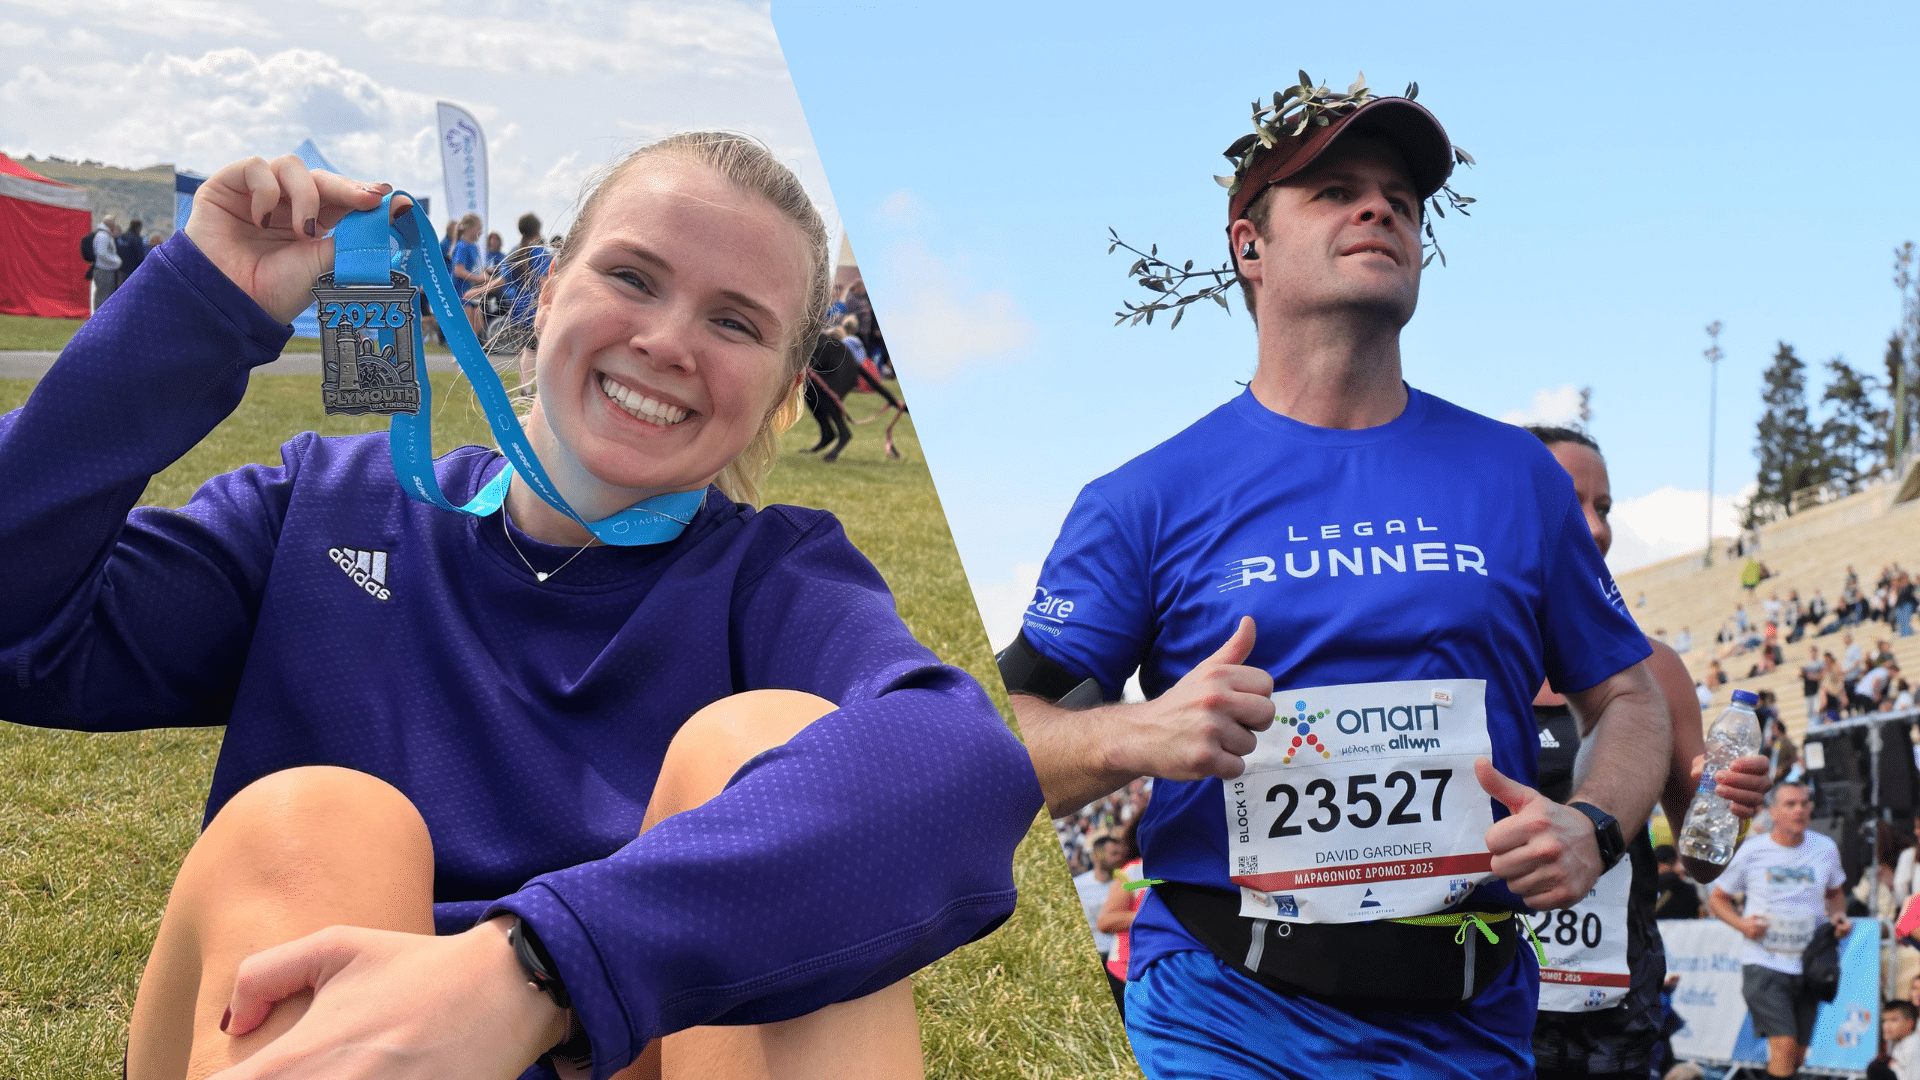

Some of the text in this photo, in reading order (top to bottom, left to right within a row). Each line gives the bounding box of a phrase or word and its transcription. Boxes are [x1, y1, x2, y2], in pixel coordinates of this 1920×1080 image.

[325, 302, 406, 328] 2026
[326, 389, 416, 404] PLYMOUTH
[1288, 517, 1438, 541] LEGAL
[328, 547, 391, 600] adidas
[1238, 542, 1488, 587] RUNNER
[1388, 734, 1440, 753] allwyn
[1234, 782, 1250, 844] BLOCK 13
[1265, 769, 1453, 839] 23527
[1315, 842, 1433, 864] DAVID GARDNER
[1294, 862, 1434, 886] ΜΑΡΑΘΩΝΙΟΣ ΔΡΟΜΟΣ 2025
[1515, 910, 1602, 949] 280
